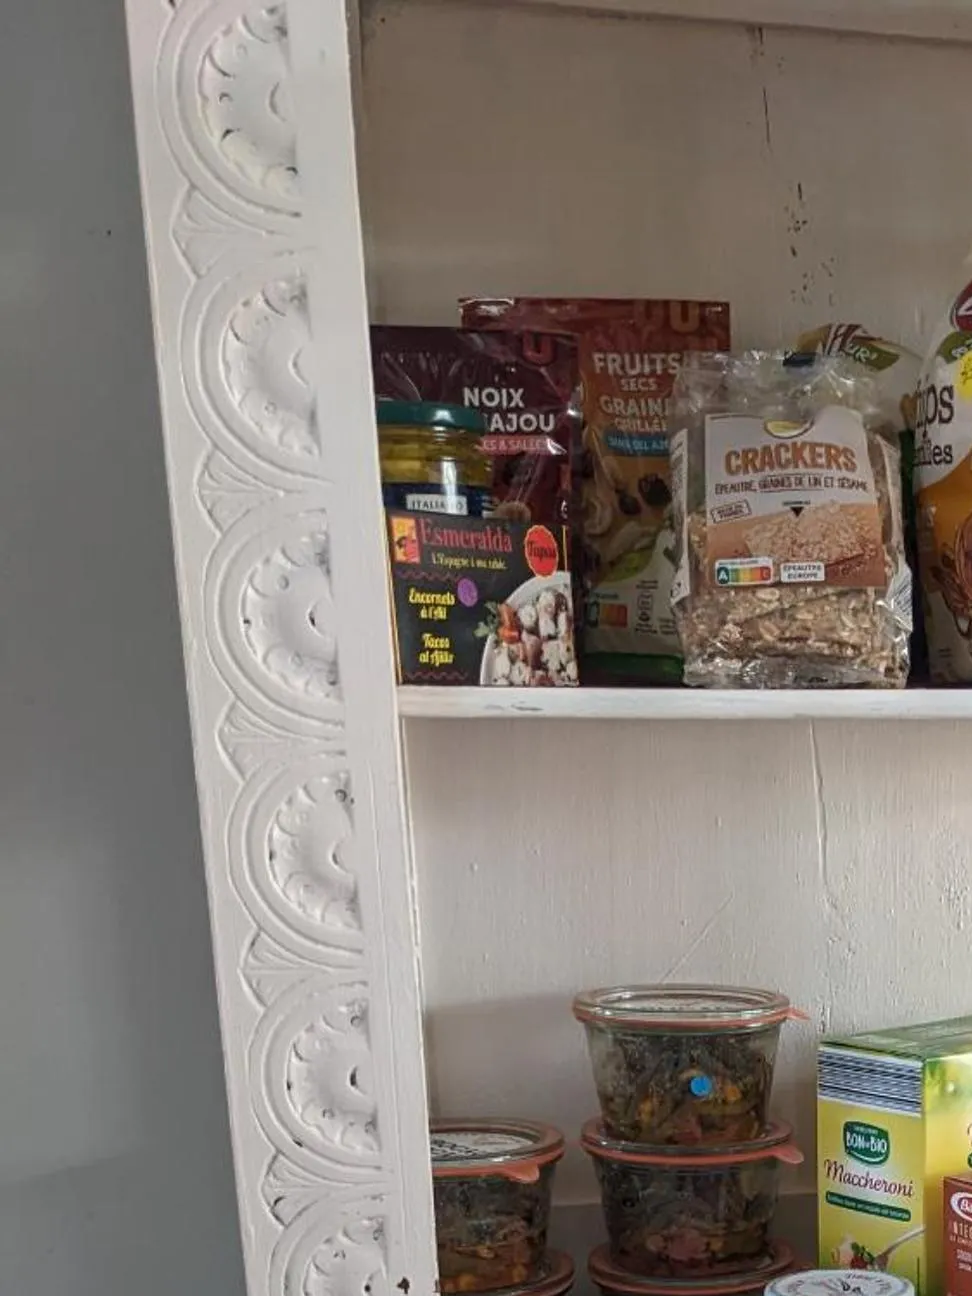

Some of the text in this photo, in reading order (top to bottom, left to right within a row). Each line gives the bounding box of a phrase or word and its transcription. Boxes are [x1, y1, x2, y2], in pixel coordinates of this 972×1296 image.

[592, 353, 682, 376] FRUITS
[619, 377, 658, 392] SECS
[463, 387, 525, 409] NOIX
[482, 412, 556, 434] AJOU
[723, 441, 858, 477] CRACKERS
[419, 517, 513, 552] Esmeralda
[846, 1131, 866, 1150] BON
[870, 1135, 888, 1155] BIO
[823, 1159, 914, 1199] Maccheroni
